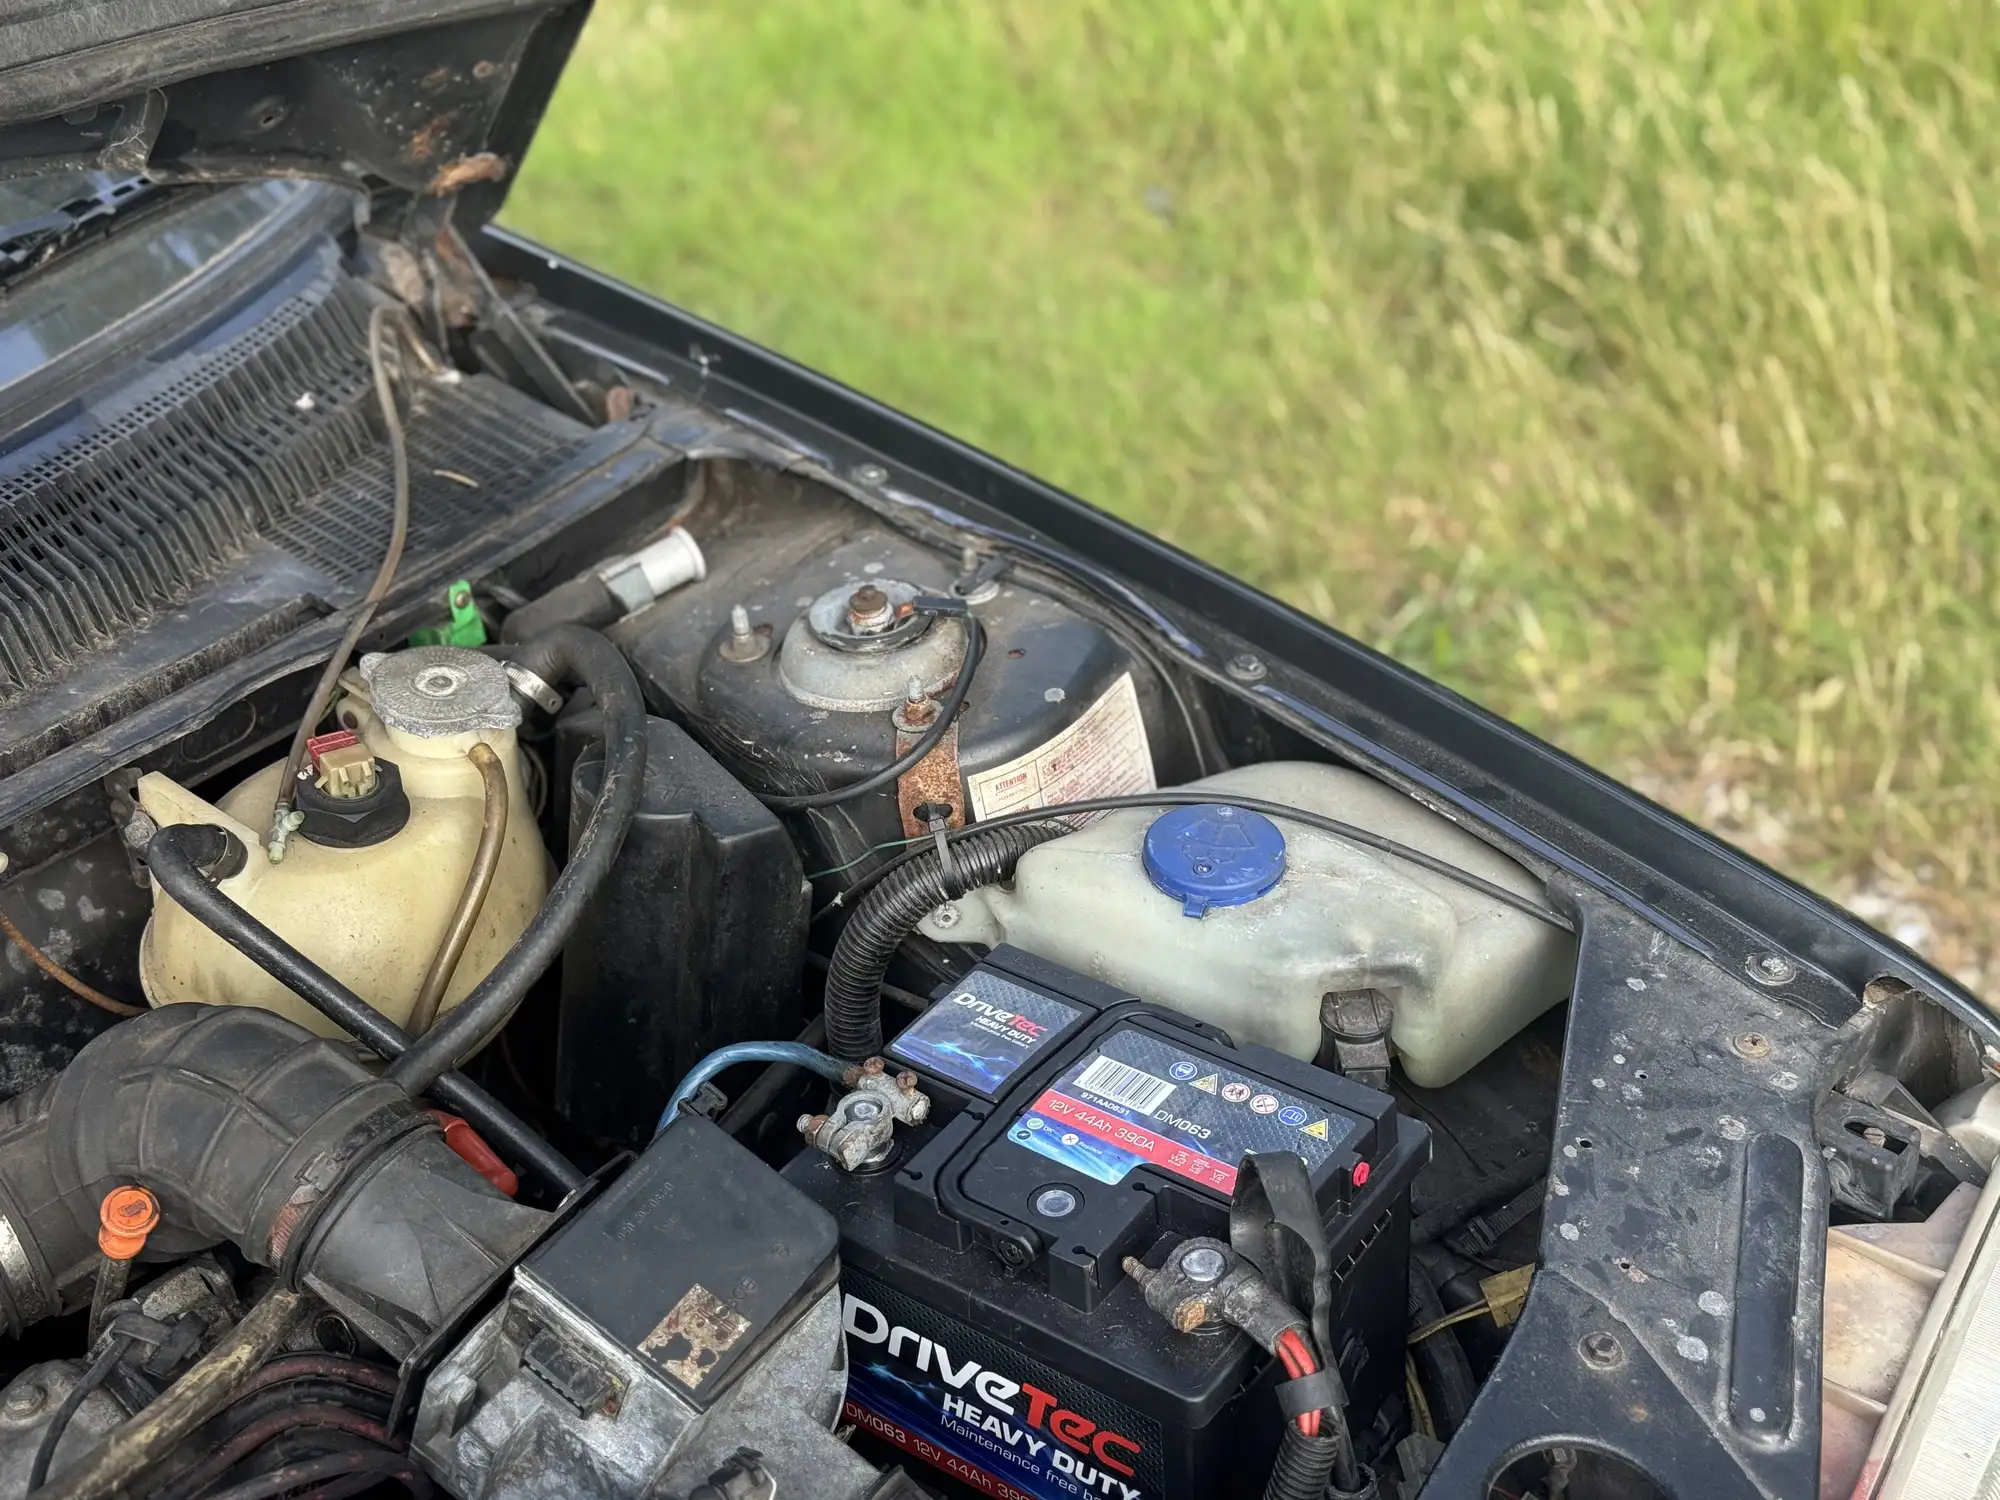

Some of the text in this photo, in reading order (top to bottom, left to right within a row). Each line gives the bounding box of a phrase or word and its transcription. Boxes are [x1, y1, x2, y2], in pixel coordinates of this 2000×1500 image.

[995, 772, 1028, 791] ATTENTION
[975, 1015, 1010, 1032] HEAVY
[1007, 1029, 1036, 1044] DUTY
[1049, 1099, 1156, 1153] 12V 44Ah 390A
[1154, 1109, 1212, 1140] DM063
[845, 1402, 907, 1443] DM063
[913, 1439, 941, 1461] 12V
[947, 1459, 991, 1489] 44Ah
[940, 1414, 1040, 1475] Maintenance
[1045, 1470, 1078, 1494] free
[943, 1392, 1142, 1500] HEAVY DUTY
